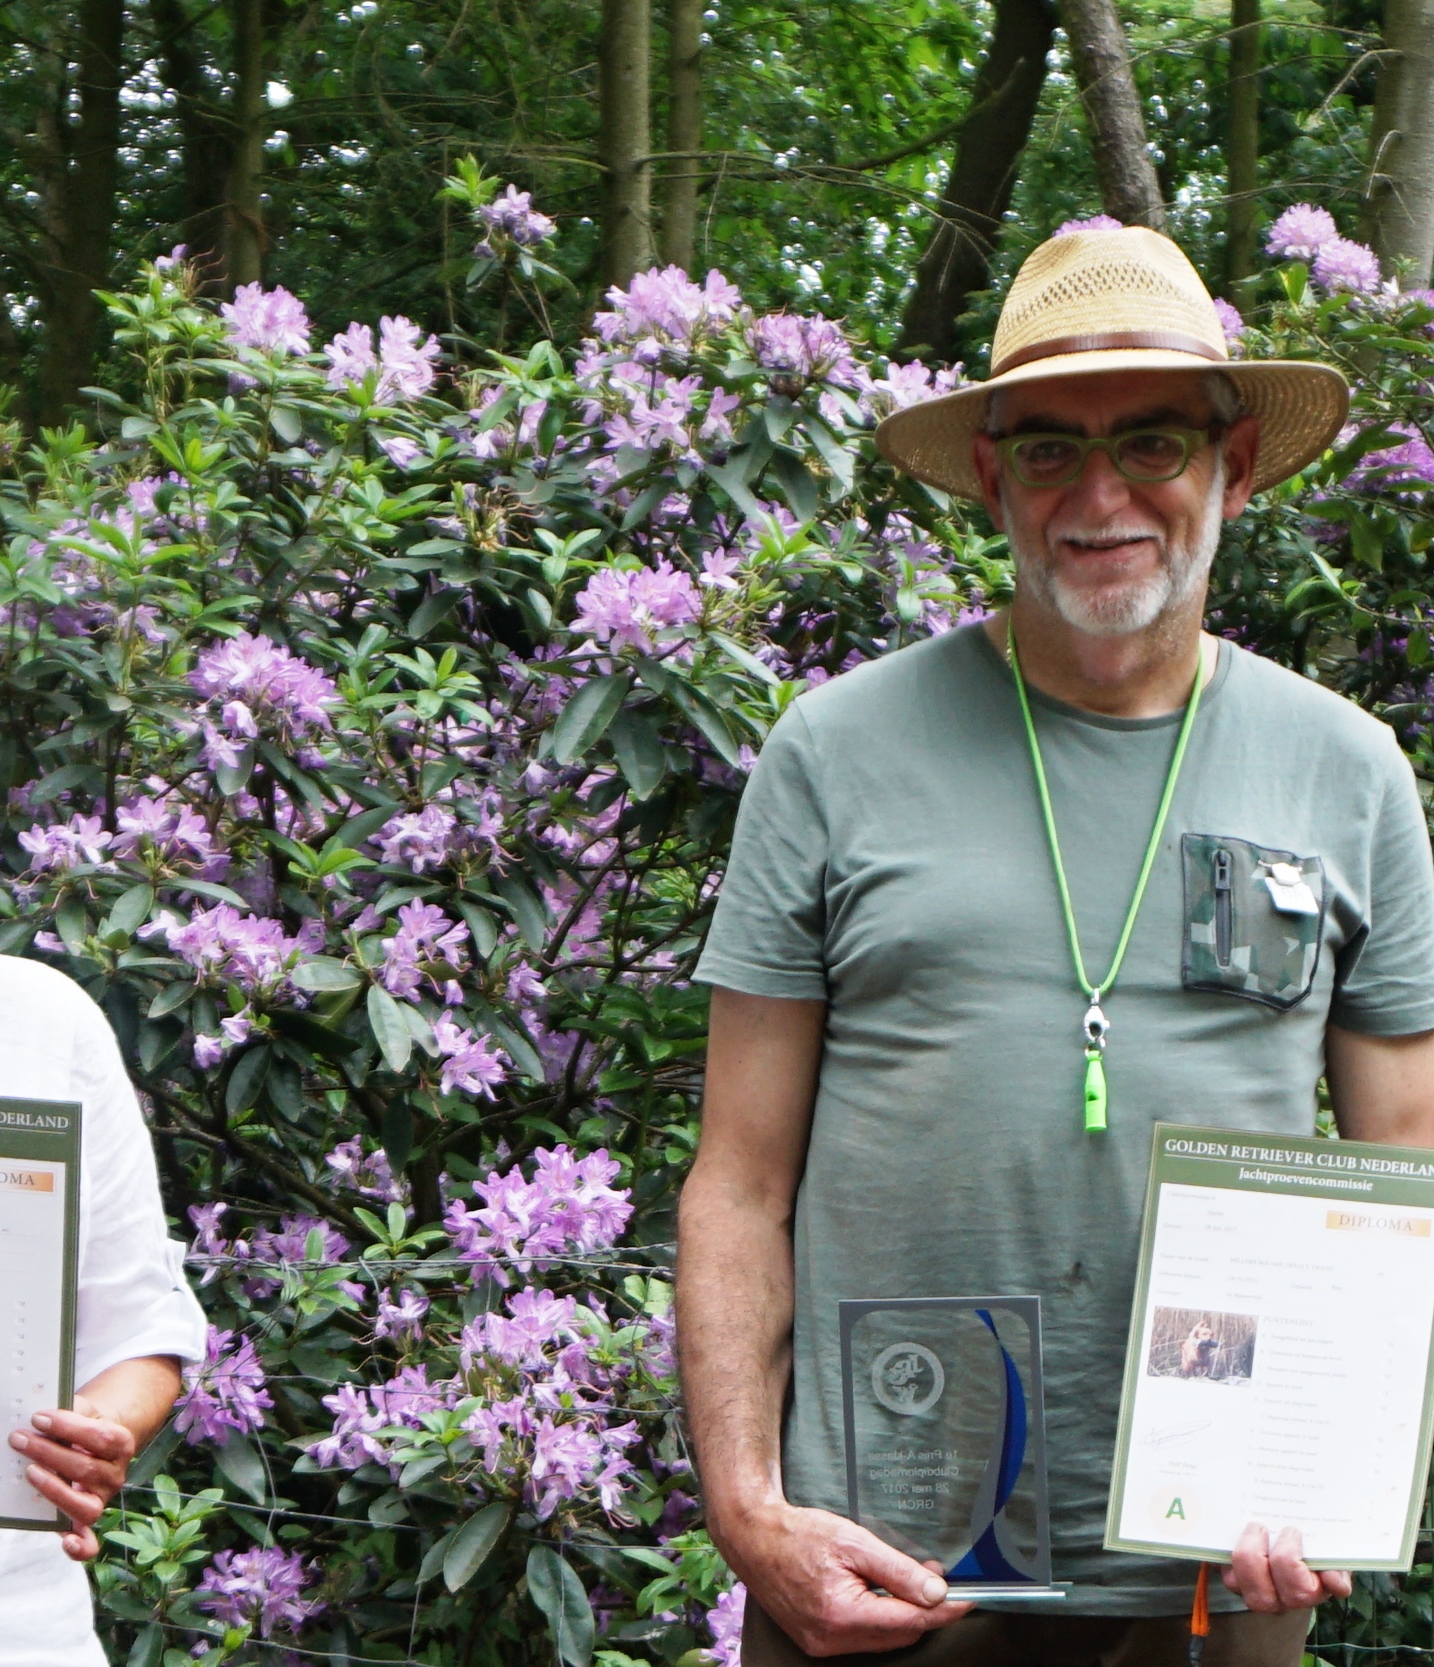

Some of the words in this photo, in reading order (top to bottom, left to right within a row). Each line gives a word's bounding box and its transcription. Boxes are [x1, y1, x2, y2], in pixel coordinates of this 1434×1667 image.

[1165, 1139, 1228, 1156] GOLDEN
[1231, 1145, 1313, 1166] RETRIEVER
[1317, 1153, 1356, 1169] CLUB
[1238, 1167, 1373, 1191] Jachtproevencommissie
[1339, 1214, 1412, 1232] DIPLOMA
[1165, 1496, 1186, 1520] A
